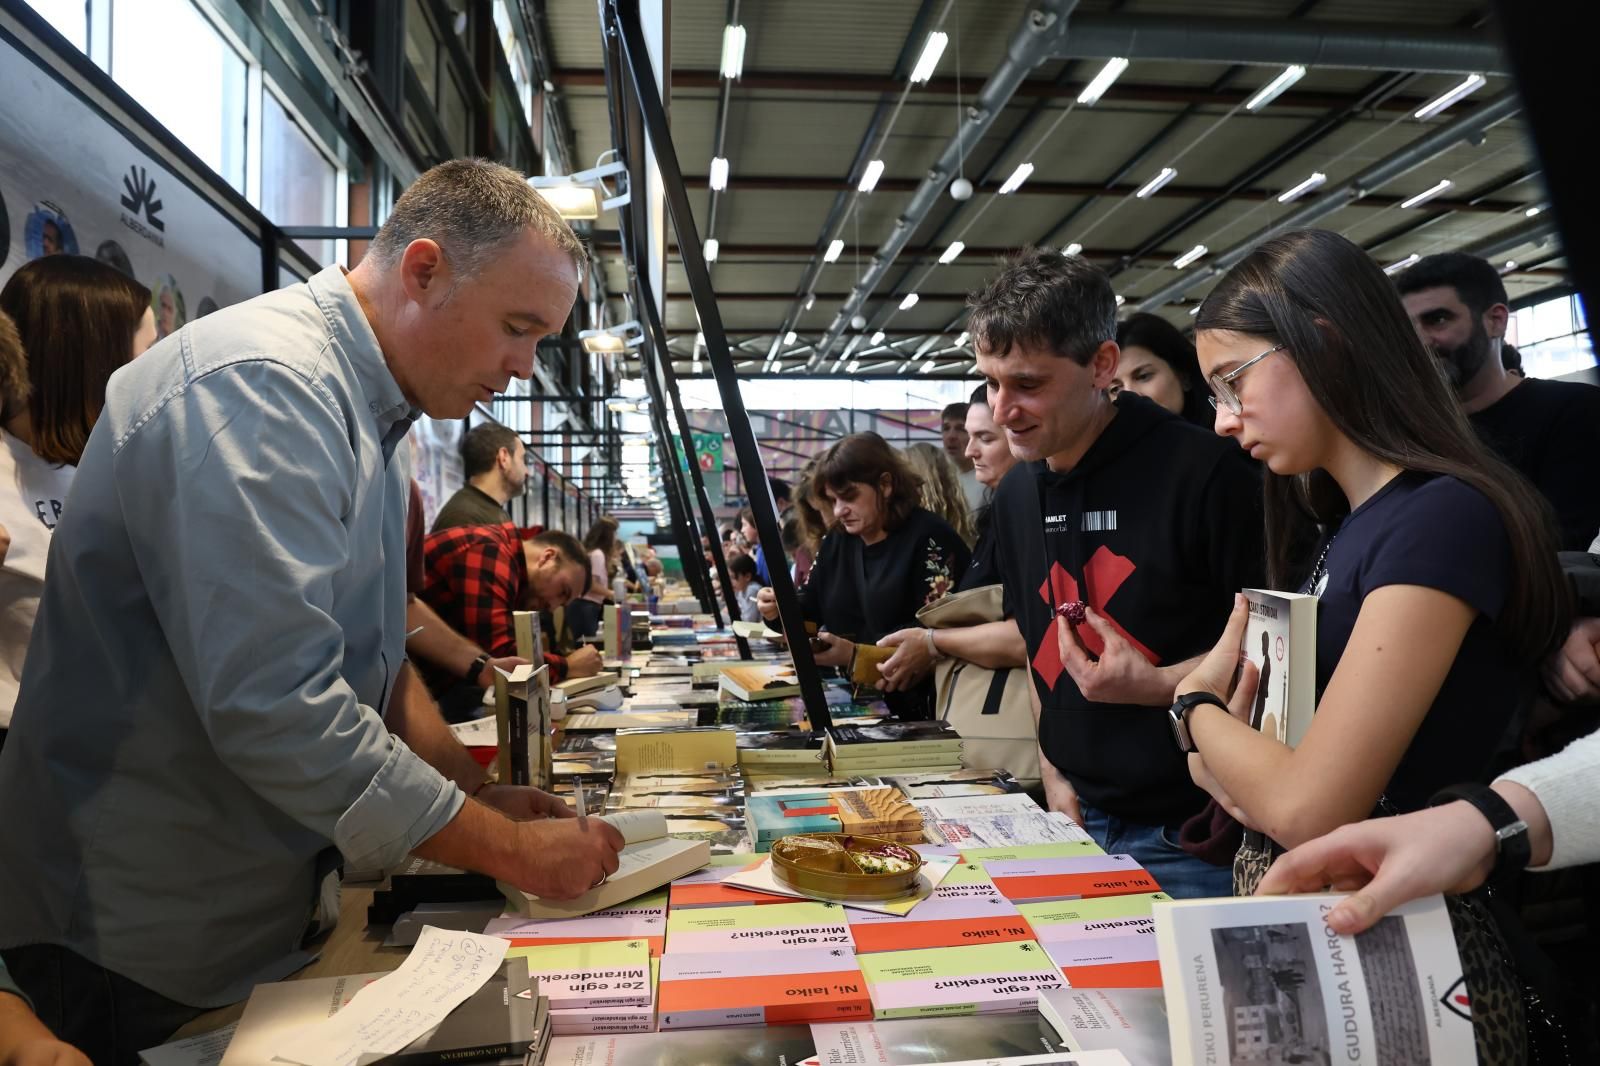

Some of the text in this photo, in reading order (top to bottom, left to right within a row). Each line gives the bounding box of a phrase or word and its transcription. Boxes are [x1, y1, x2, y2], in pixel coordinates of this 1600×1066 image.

[1093, 879, 1150, 889] Ni, laiko
[937, 891, 968, 899] egin
[730, 926, 846, 939] Miranderekin?
[962, 927, 1025, 938] Ni, laiko
[782, 937, 817, 946] egin
[569, 981, 645, 993] Zer egin
[934, 974, 1057, 990] Miranderekin?
[785, 984, 859, 997] Ni, laiko
[993, 986, 1030, 995] egin
[1193, 954, 1216, 1028] PERURENA
[1427, 974, 1441, 1028] ALBERDANIA
[1070, 1014, 1088, 1029] Bide
[1337, 980, 1361, 1062] GUDURA
[440, 1046, 507, 1060] EGUN GORRIETAN
[827, 1048, 842, 1064] Bide
